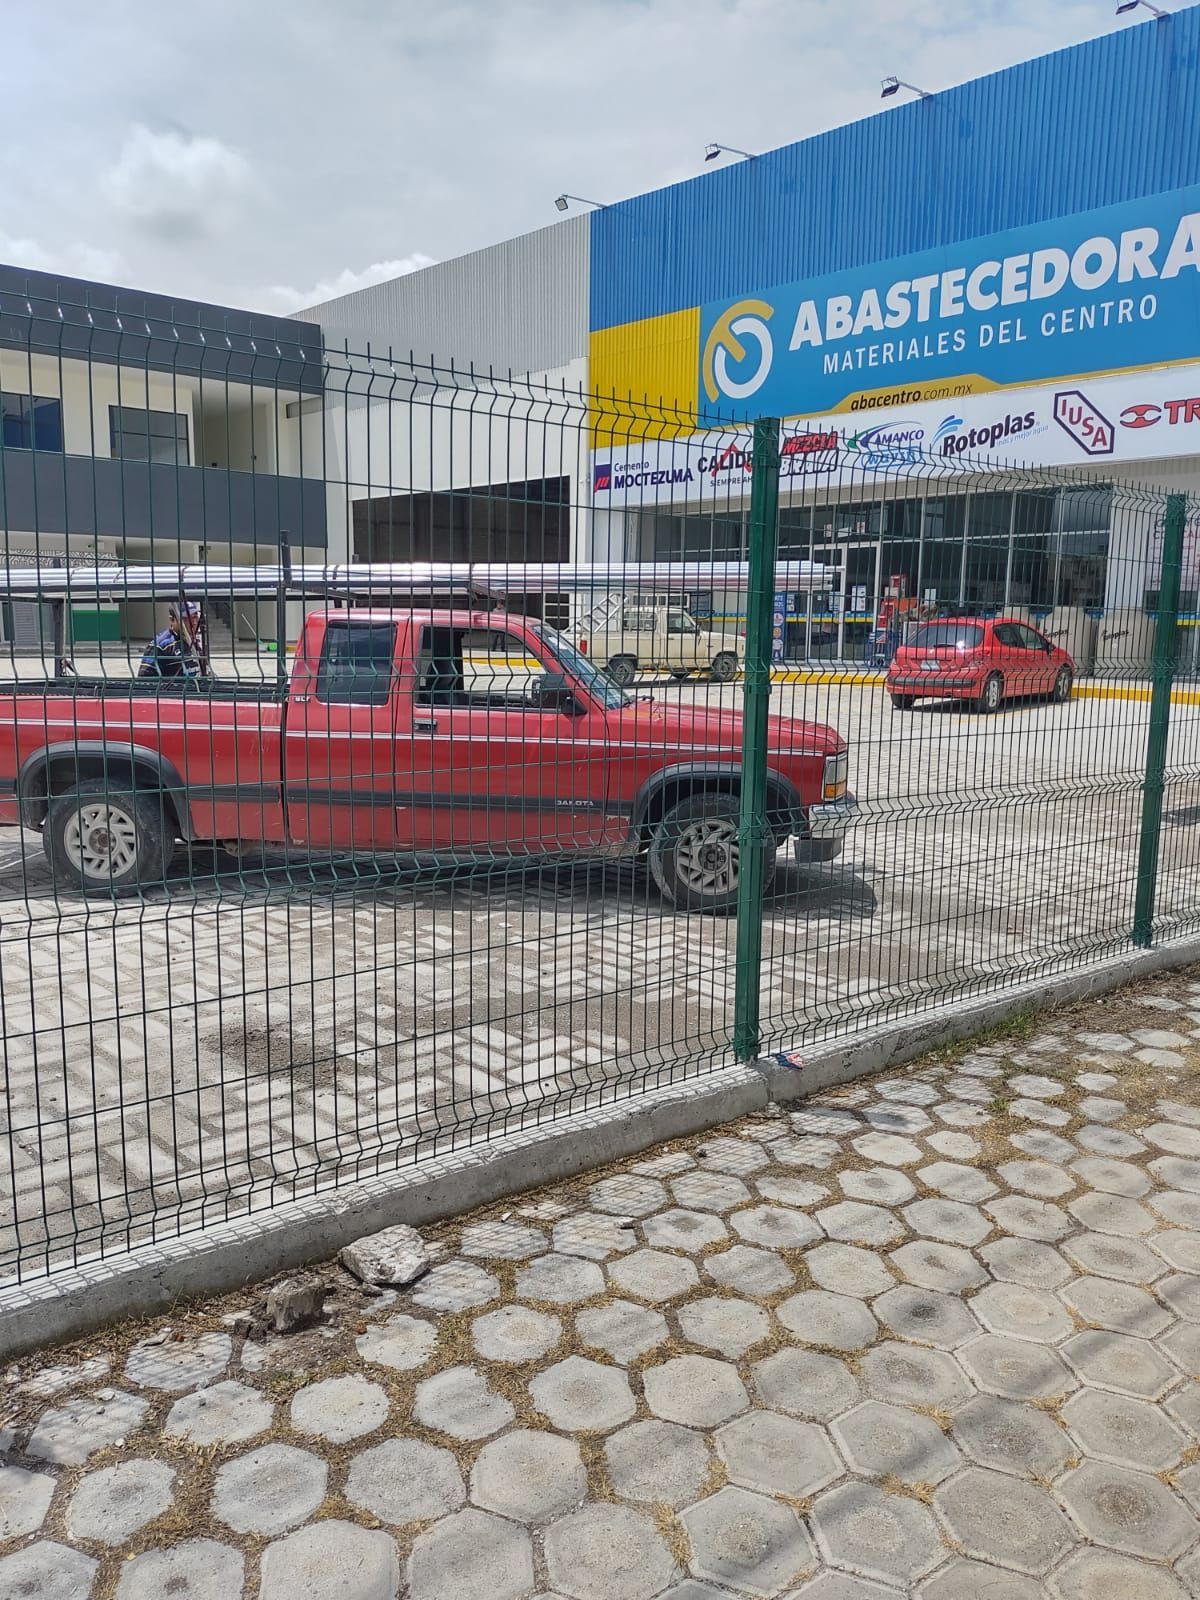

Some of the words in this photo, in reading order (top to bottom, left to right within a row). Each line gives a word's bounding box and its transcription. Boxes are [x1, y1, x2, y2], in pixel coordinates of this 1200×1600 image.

[788, 212, 1200, 351] ABASTECEDORA
[823, 329, 966, 374] MATERIALES
[980, 318, 1027, 348] DEL
[1041, 294, 1157, 337] CENTRO
[850, 382, 973, 411] abacentro.com.mx
[874, 429, 924, 444] AMANCO
[943, 411, 1035, 456] Rotoplas
[1061, 399, 1107, 447] IUSA
[614, 460, 650, 473] Cemento
[614, 467, 694, 489] MOCTEZUMA
